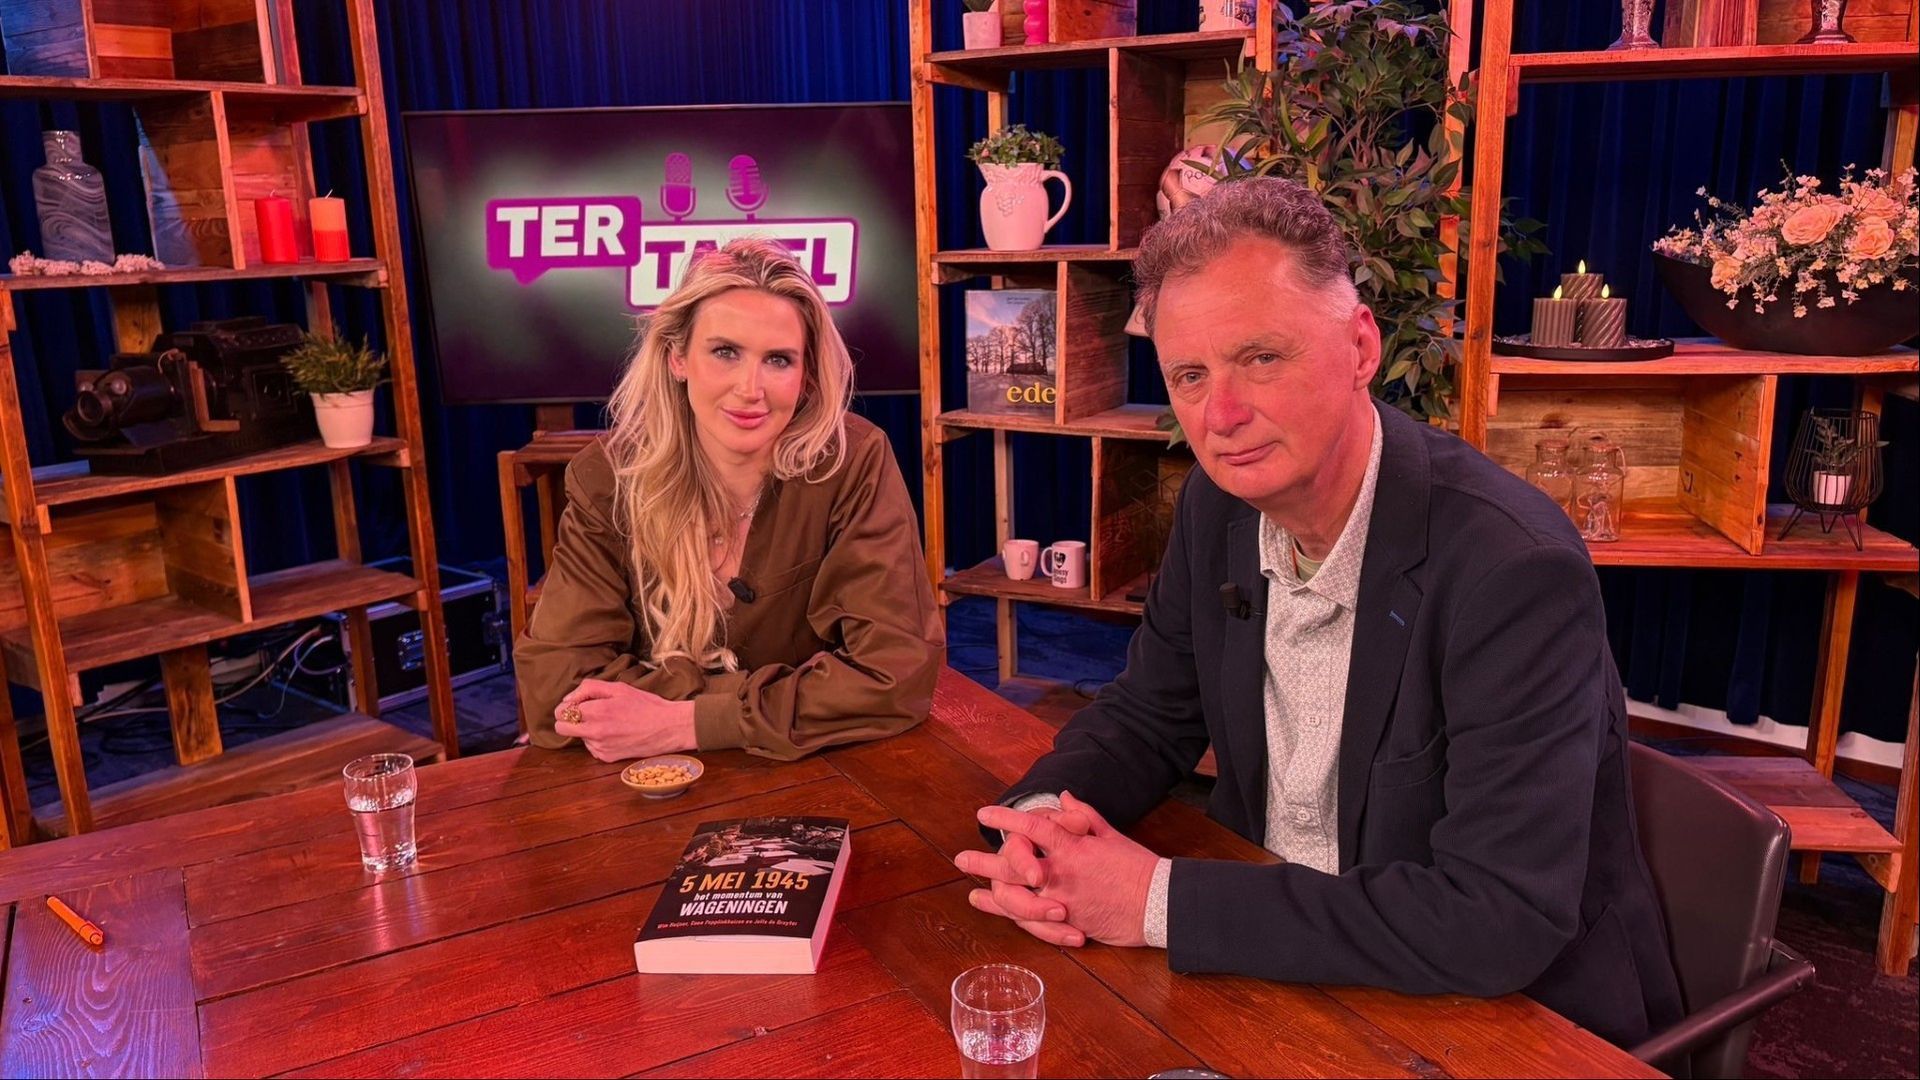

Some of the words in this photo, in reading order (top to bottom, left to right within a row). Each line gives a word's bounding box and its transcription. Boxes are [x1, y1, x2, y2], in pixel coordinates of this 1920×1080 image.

[496, 204, 625, 258] TER
[1006, 382, 1056, 403] ede
[679, 875, 698, 892] 5
[699, 872, 746, 891] MEI
[751, 871, 809, 890] 1945
[694, 893, 708, 901] het
[712, 891, 762, 900] momentum
[679, 900, 788, 917] WAGENINGEN
